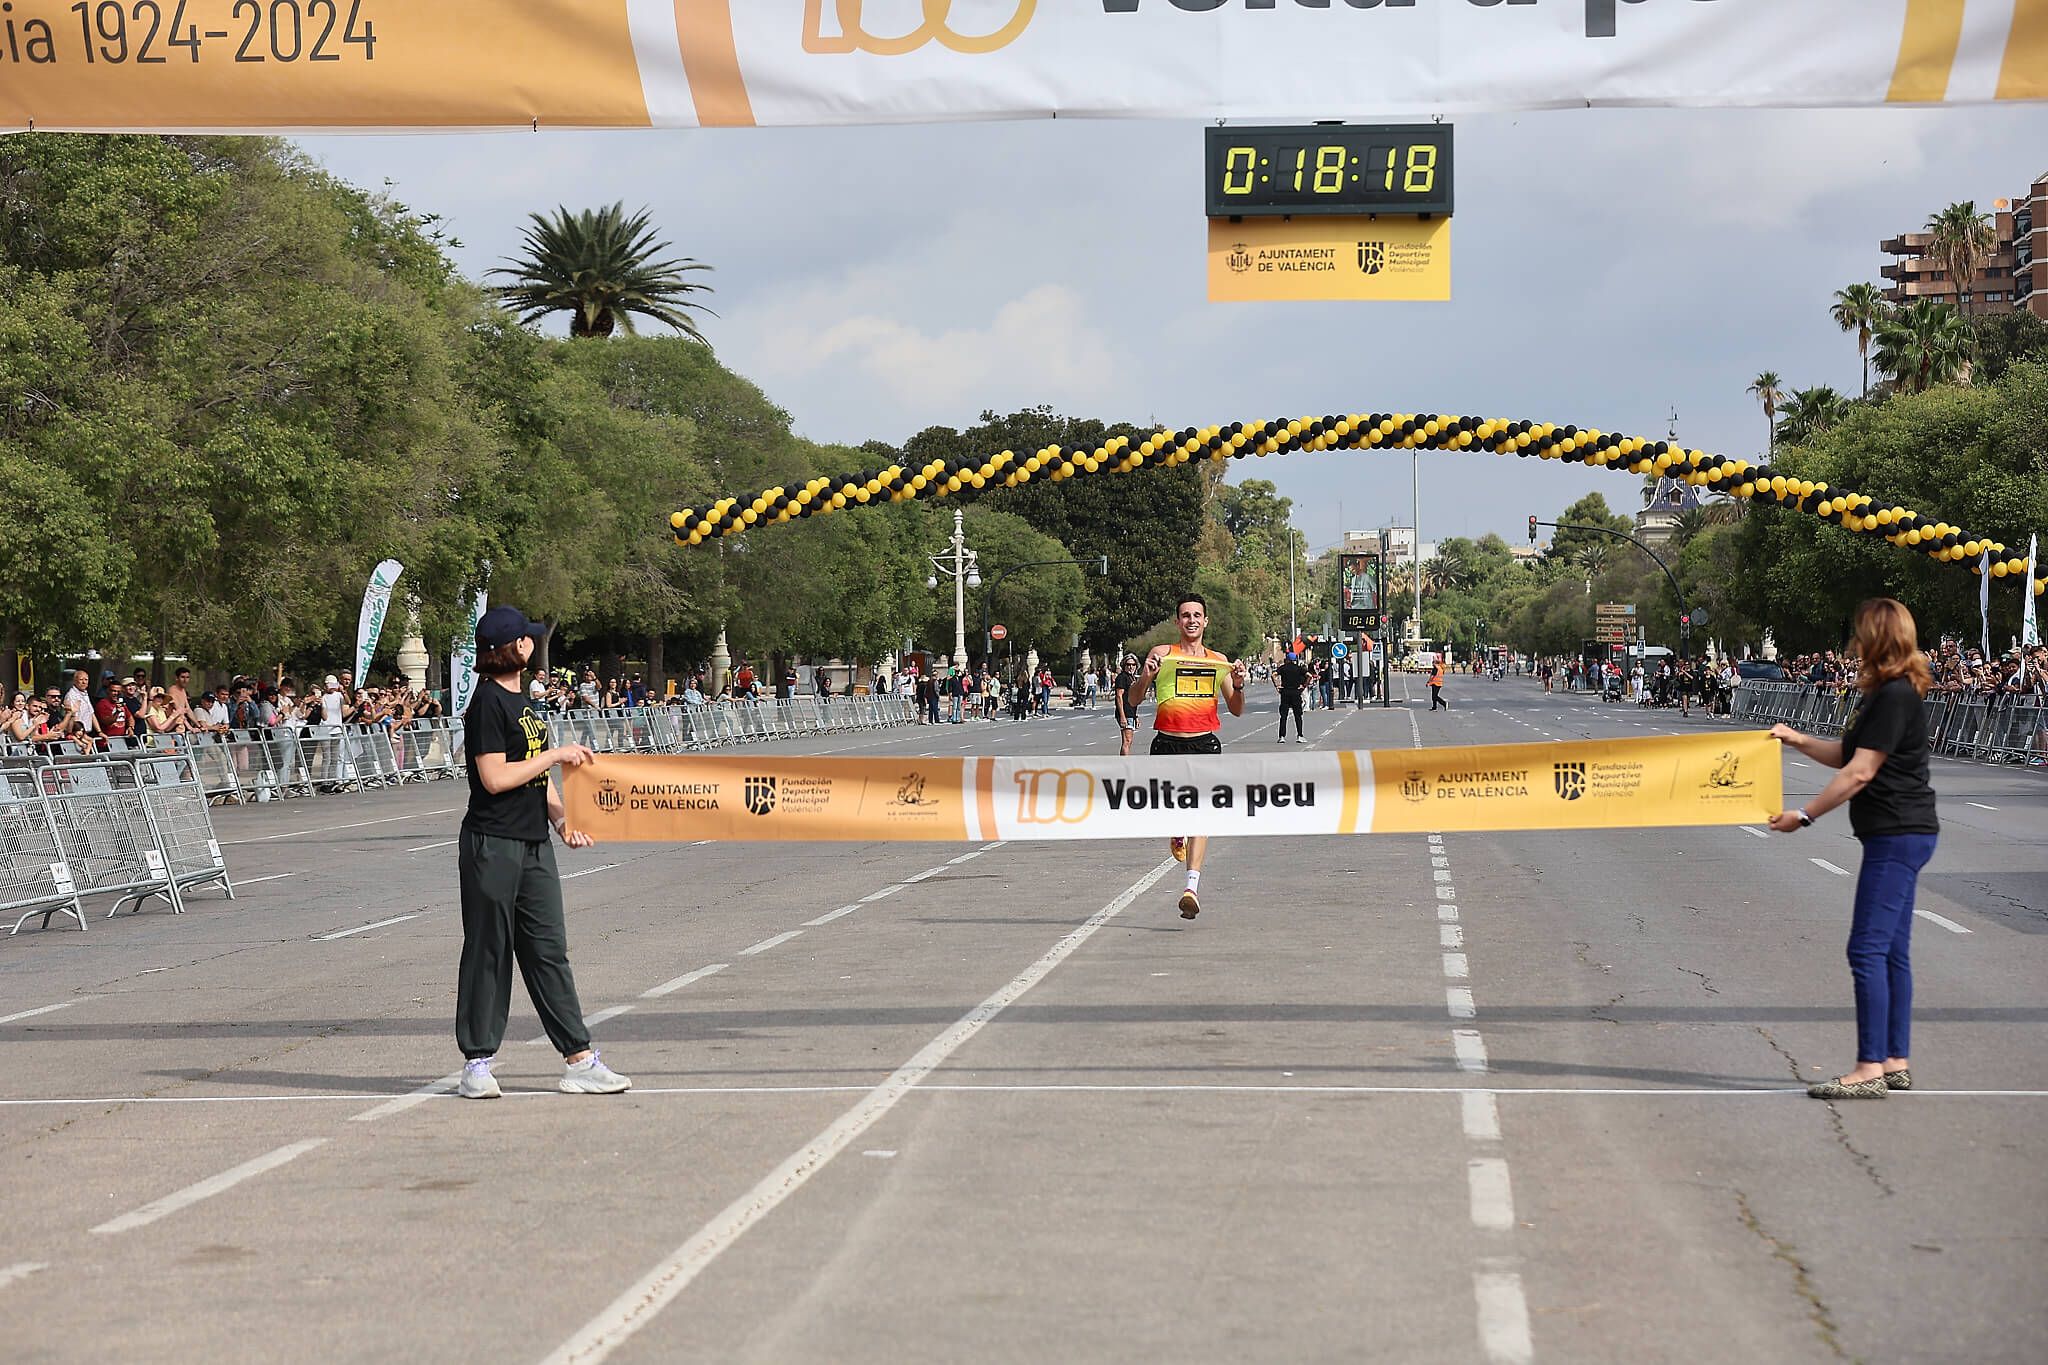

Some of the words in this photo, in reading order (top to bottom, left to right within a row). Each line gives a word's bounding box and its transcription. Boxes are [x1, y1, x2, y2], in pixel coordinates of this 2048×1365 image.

[0, 2, 57, 63] ia
[71, 0, 377, 63] 1924-2024
[1223, 145, 1437, 195] 0:18:18
[1389, 242, 1432, 250] Fundación
[1258, 248, 1336, 260] AJUNTAMENT
[1389, 250, 1430, 259] Deportiva
[1258, 262, 1273, 272] DE
[1389, 258, 1430, 266] Municipal
[1348, 616, 1376, 626] 10:18
[1194, 679, 1199, 691] 1
[1591, 762, 1643, 771] Fundación
[1437, 770, 1529, 783] AJUNTAMENT
[1591, 771, 1641, 781] Deportiva
[781, 777, 832, 786] Fundación
[1591, 780, 1641, 789] Municipal
[630, 784, 720, 795] AJUNTAMENT
[781, 786, 830, 796] Deportiva
[1437, 787, 1456, 799] DE
[1460, 784, 1529, 798] VALÈNCIA
[781, 796, 830, 805] Municipal
[1013, 768, 1095, 824] 100
[1102, 778, 1199, 810] Volta
[1211, 784, 1233, 809] a
[1246, 781, 1315, 817] peu
[630, 799, 649, 810] DE
[653, 796, 720, 810] VALÈNCIA
